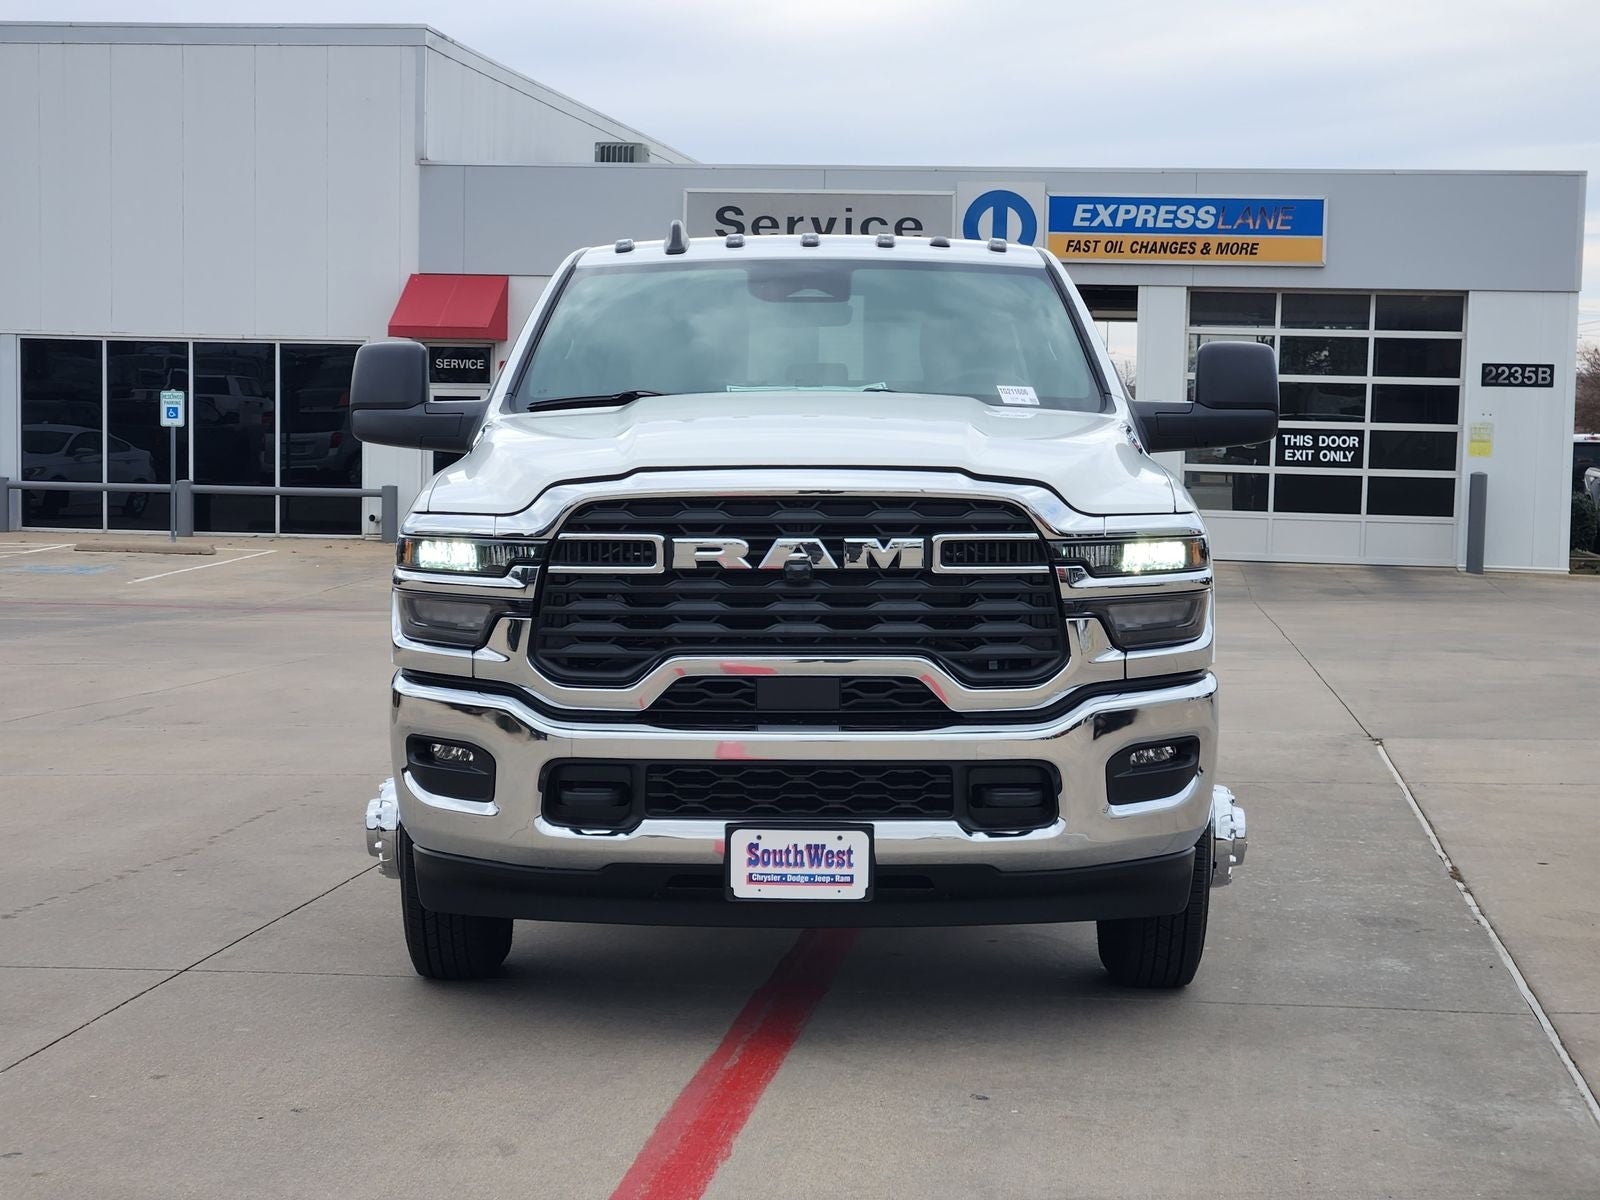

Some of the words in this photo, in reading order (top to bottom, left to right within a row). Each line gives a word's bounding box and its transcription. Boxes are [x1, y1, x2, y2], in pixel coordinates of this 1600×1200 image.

[715, 205, 923, 237] Service
[1065, 240, 1101, 253] FAST
[1104, 240, 1125, 254] OIL
[1129, 241, 1197, 255] CHANGES
[1200, 242, 1211, 255] &
[1215, 242, 1259, 256] MORE
[435, 358, 485, 370] SERVICE
[1484, 366, 1551, 385] 2235B
[1282, 434, 1313, 447] THIS
[1318, 435, 1359, 448] DOOR
[1284, 449, 1315, 461] EXIT
[1319, 450, 1354, 463] ONLY
[671, 537, 925, 569] RAM
[751, 873, 781, 883] Chrysler
[786, 874, 809, 883] Dodge
[814, 875, 831, 884] Jeep
